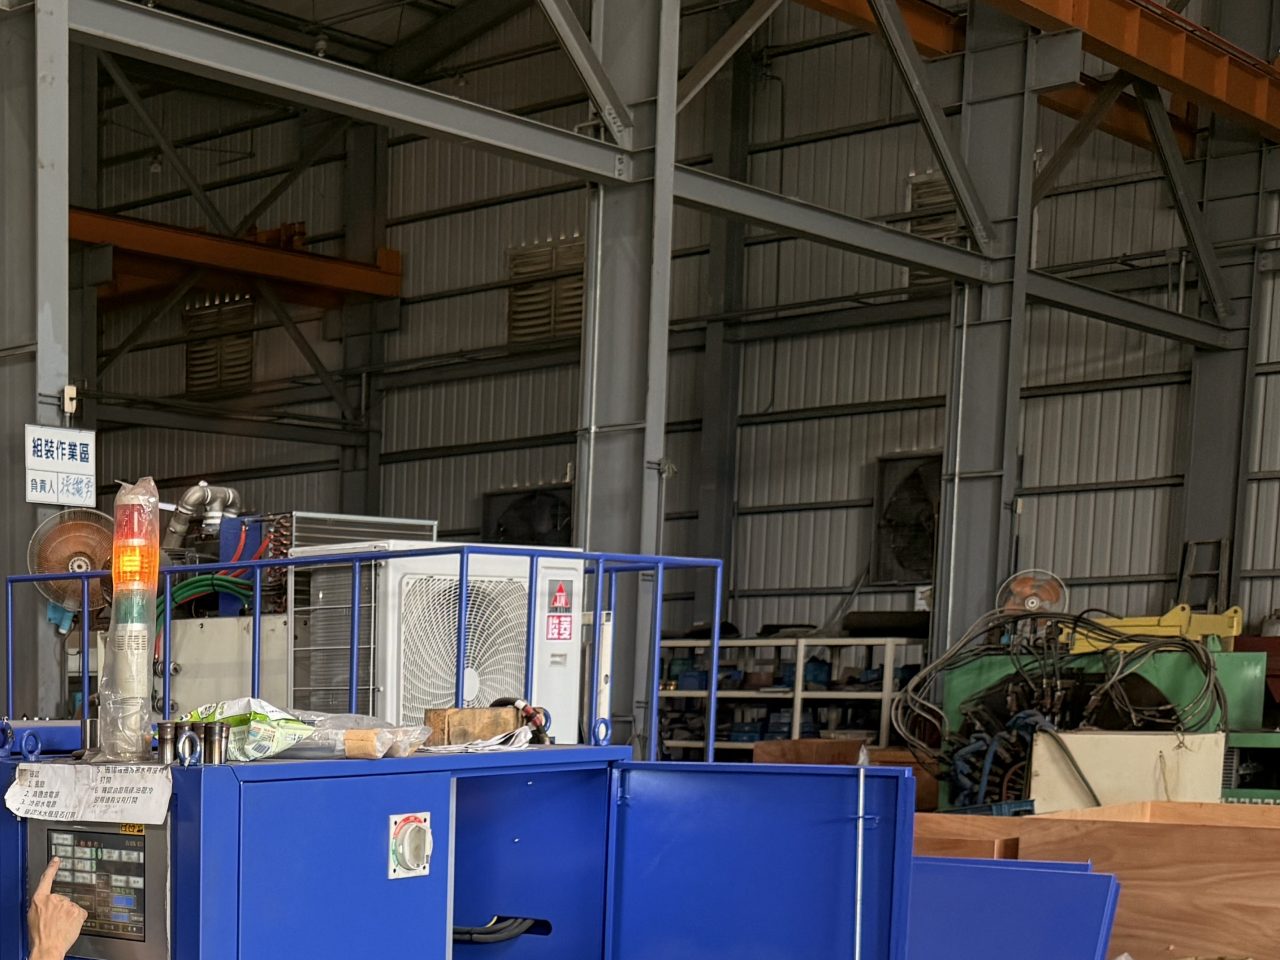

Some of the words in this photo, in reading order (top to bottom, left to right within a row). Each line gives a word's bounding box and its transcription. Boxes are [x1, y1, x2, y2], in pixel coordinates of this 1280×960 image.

[32, 437, 90, 463] 組裝作業區
[30, 478, 55, 495] 負責人
